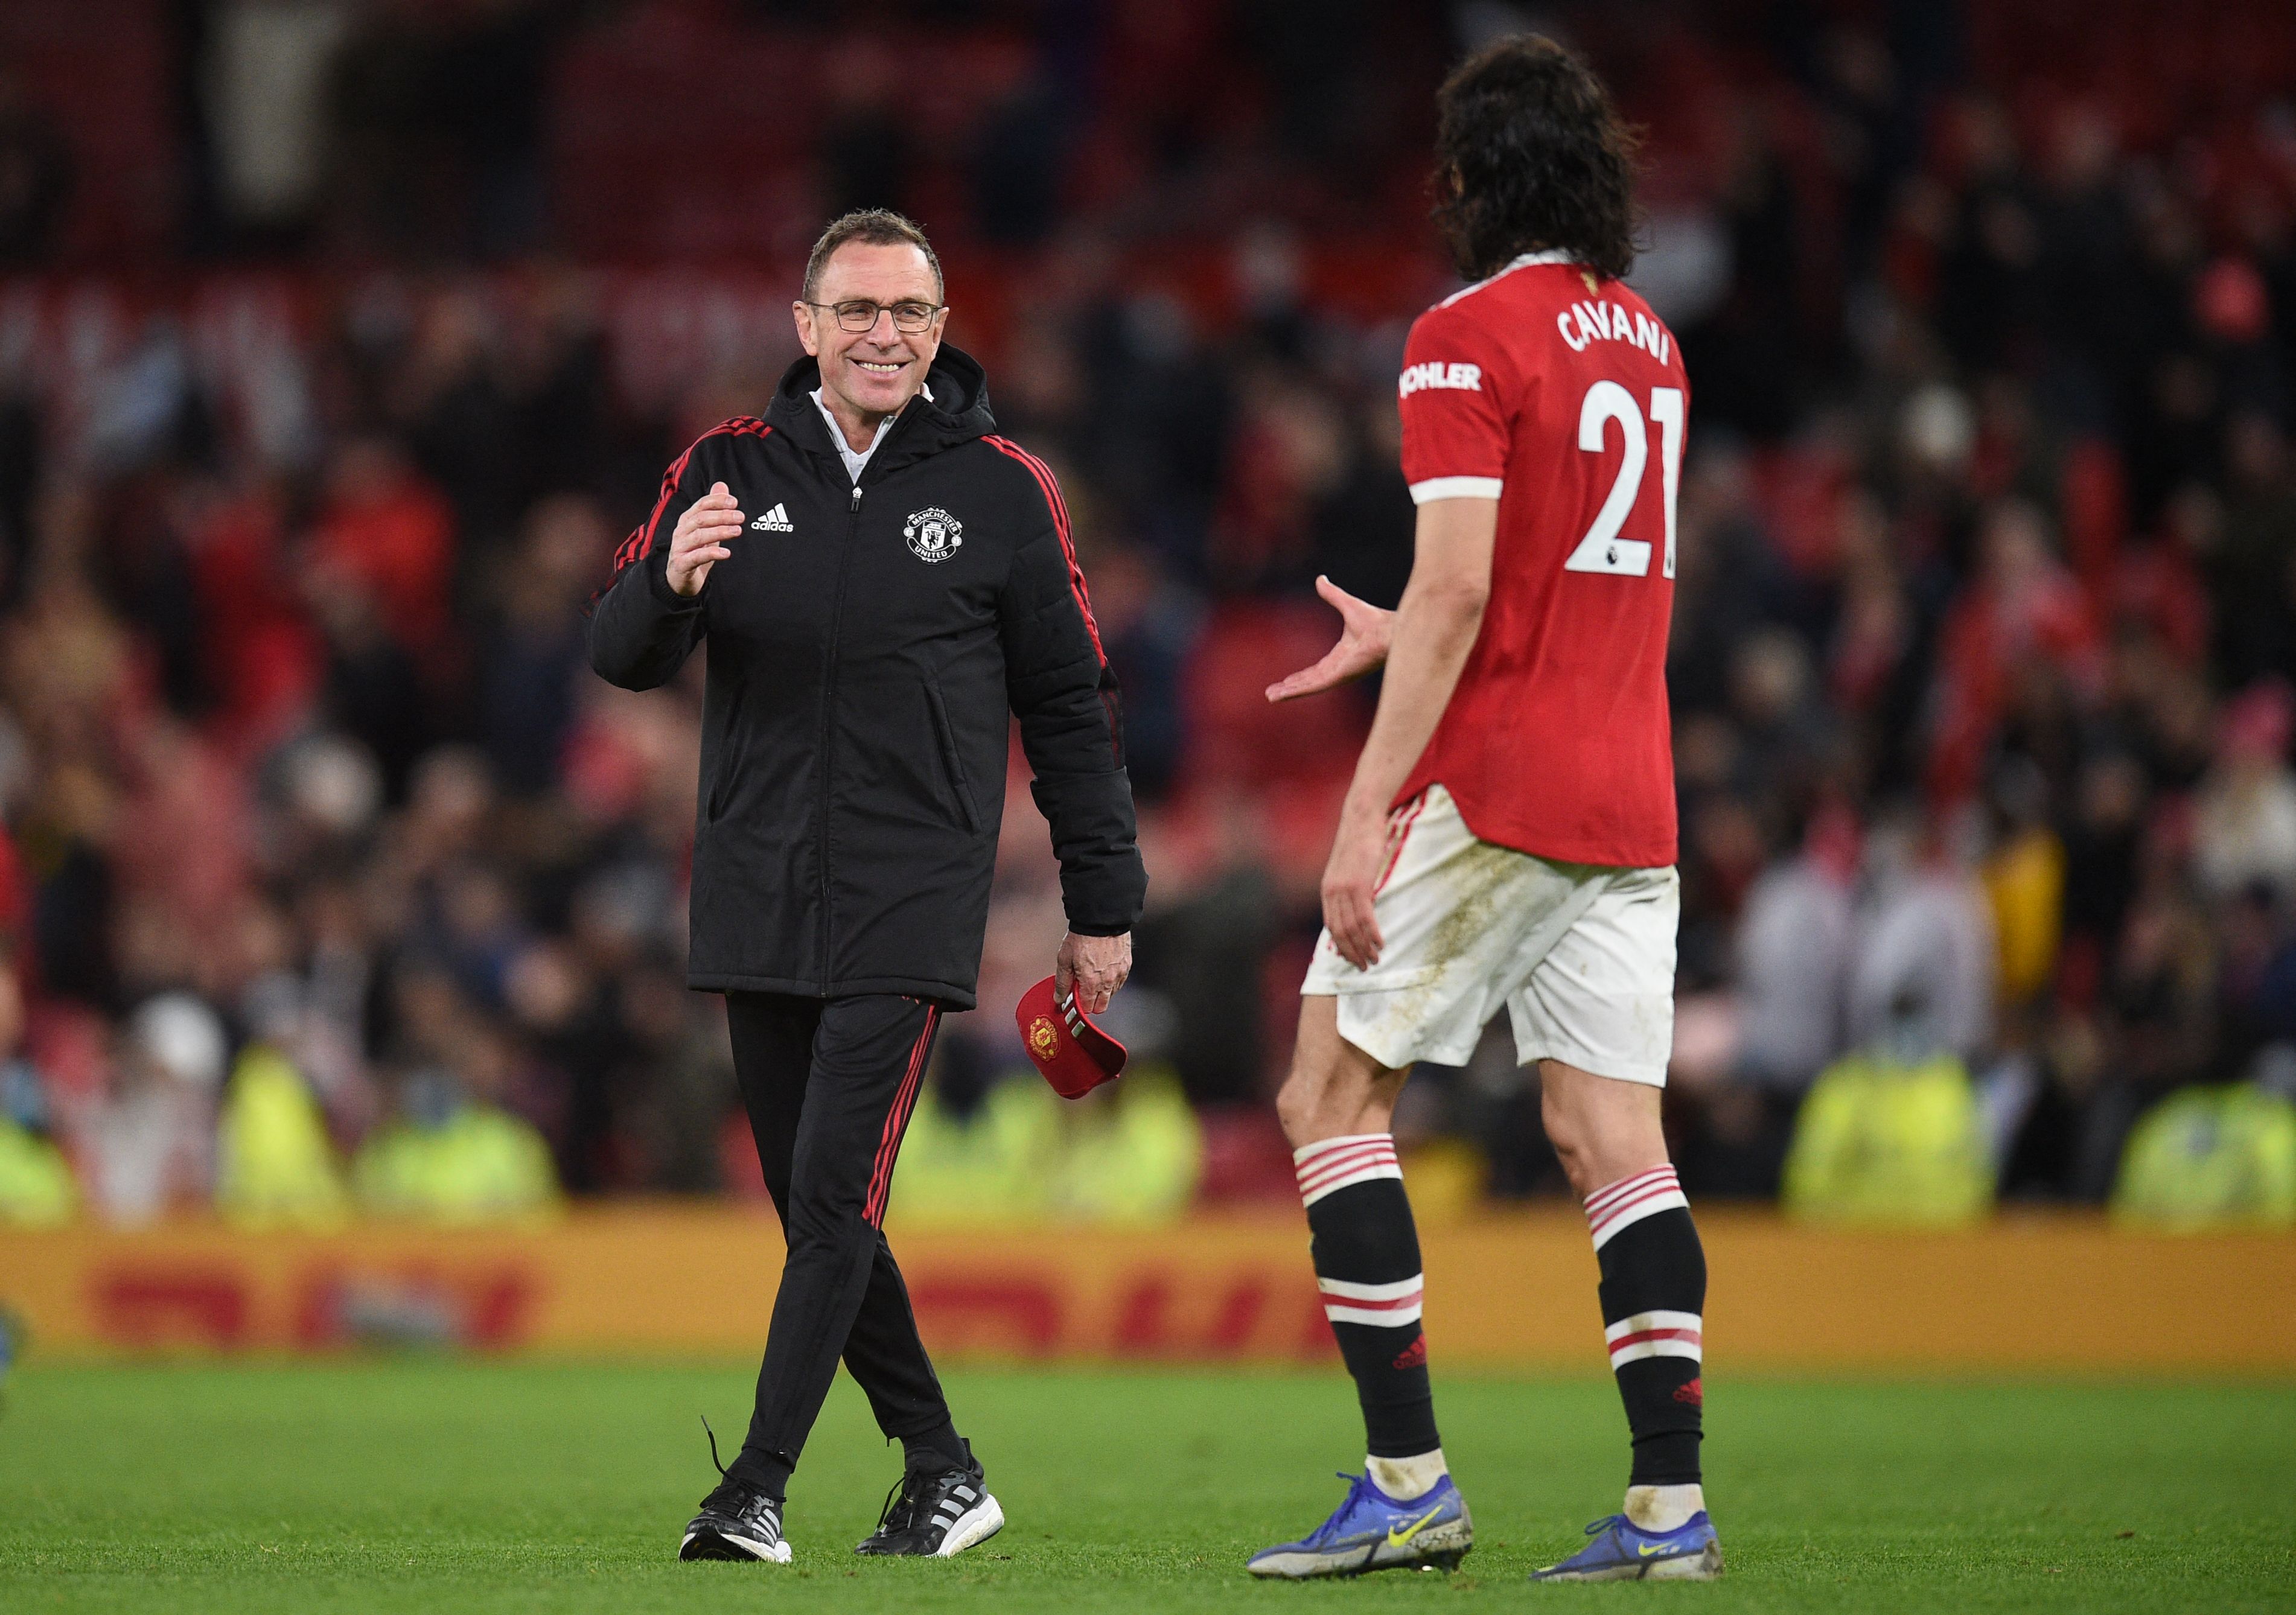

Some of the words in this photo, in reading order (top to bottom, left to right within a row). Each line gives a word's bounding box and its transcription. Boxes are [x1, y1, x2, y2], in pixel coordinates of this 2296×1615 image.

[1557, 301, 1669, 367] CAVANI
[1564, 380, 1683, 579] 21
[751, 521, 794, 532] adidas
[912, 511, 958, 532] MANCHESTER
[914, 545, 948, 558] UNITED
